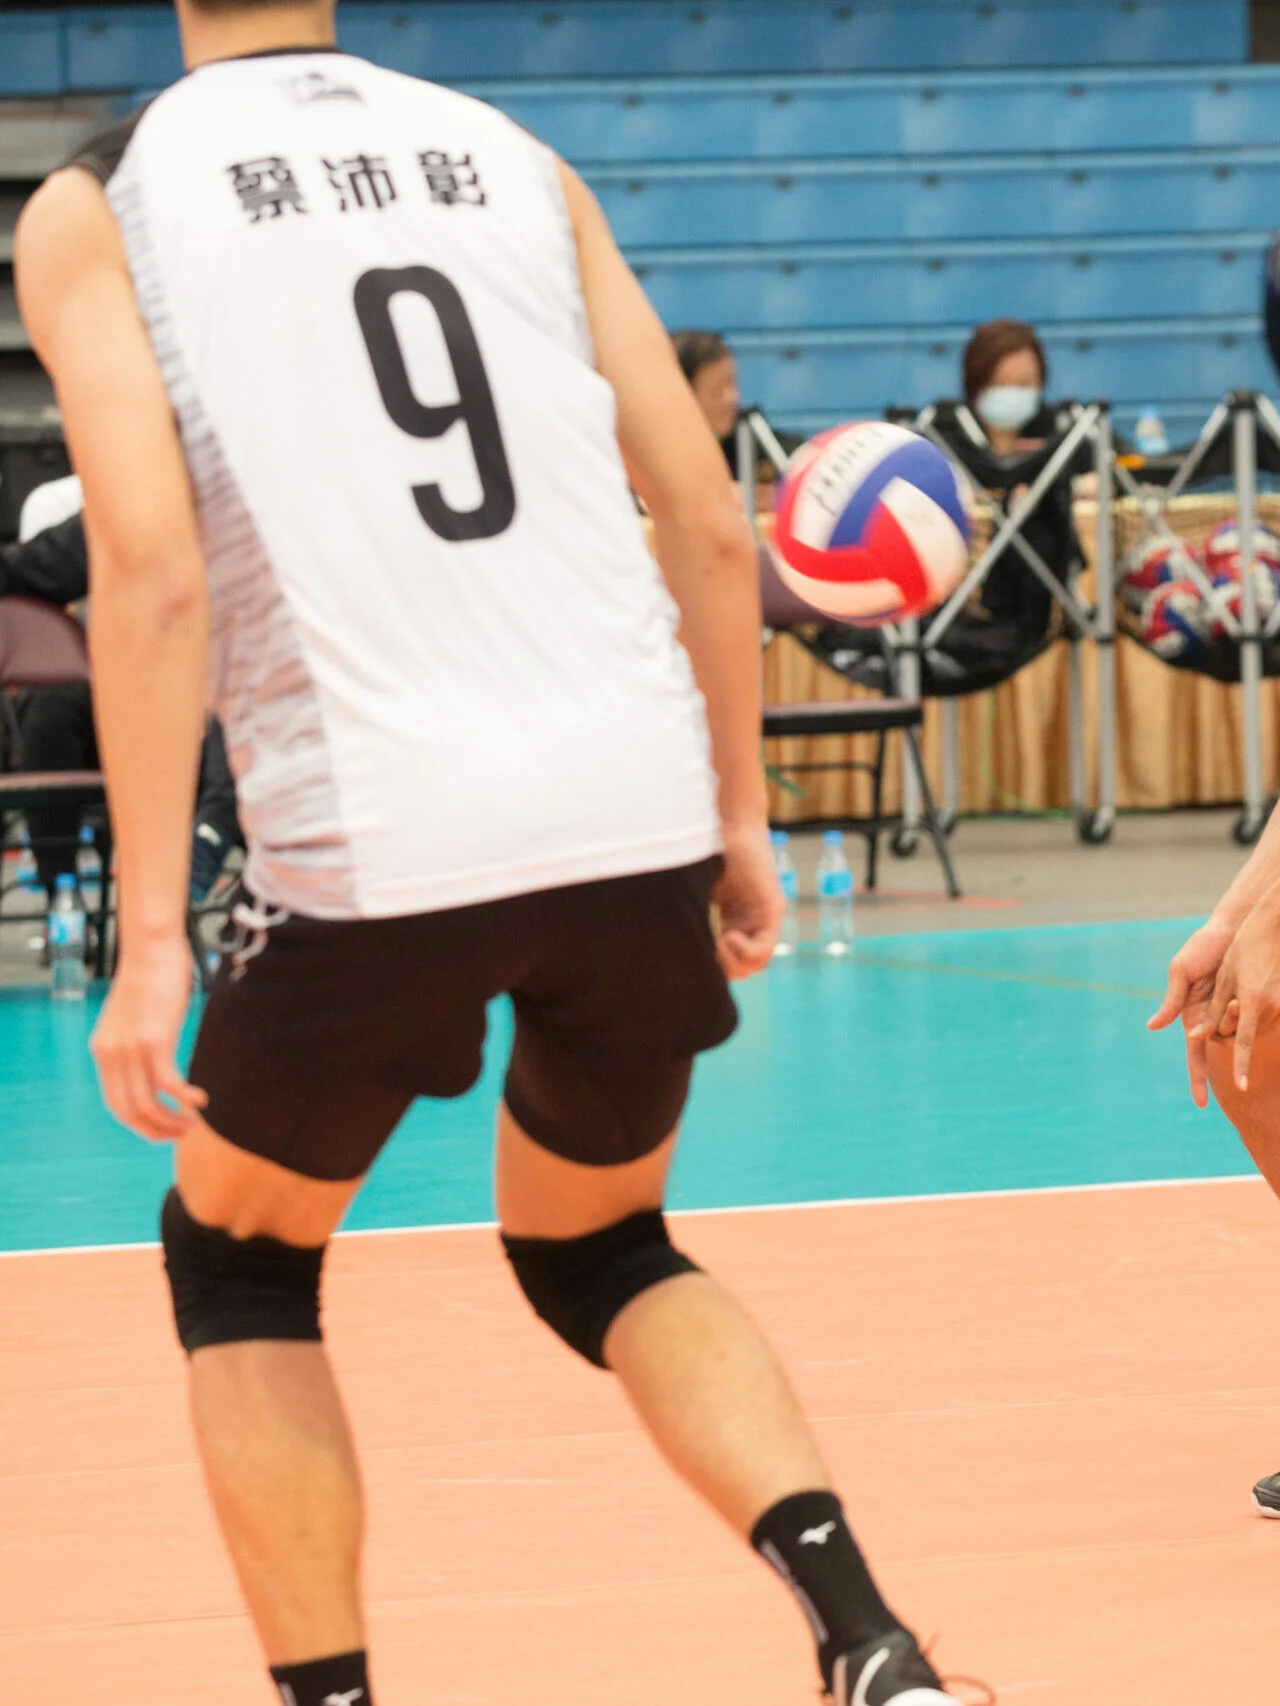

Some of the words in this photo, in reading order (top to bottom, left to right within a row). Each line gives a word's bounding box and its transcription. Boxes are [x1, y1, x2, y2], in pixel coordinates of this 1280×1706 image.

[226, 150, 488, 223] 蔡沛彰
[353, 265, 516, 541] 9
